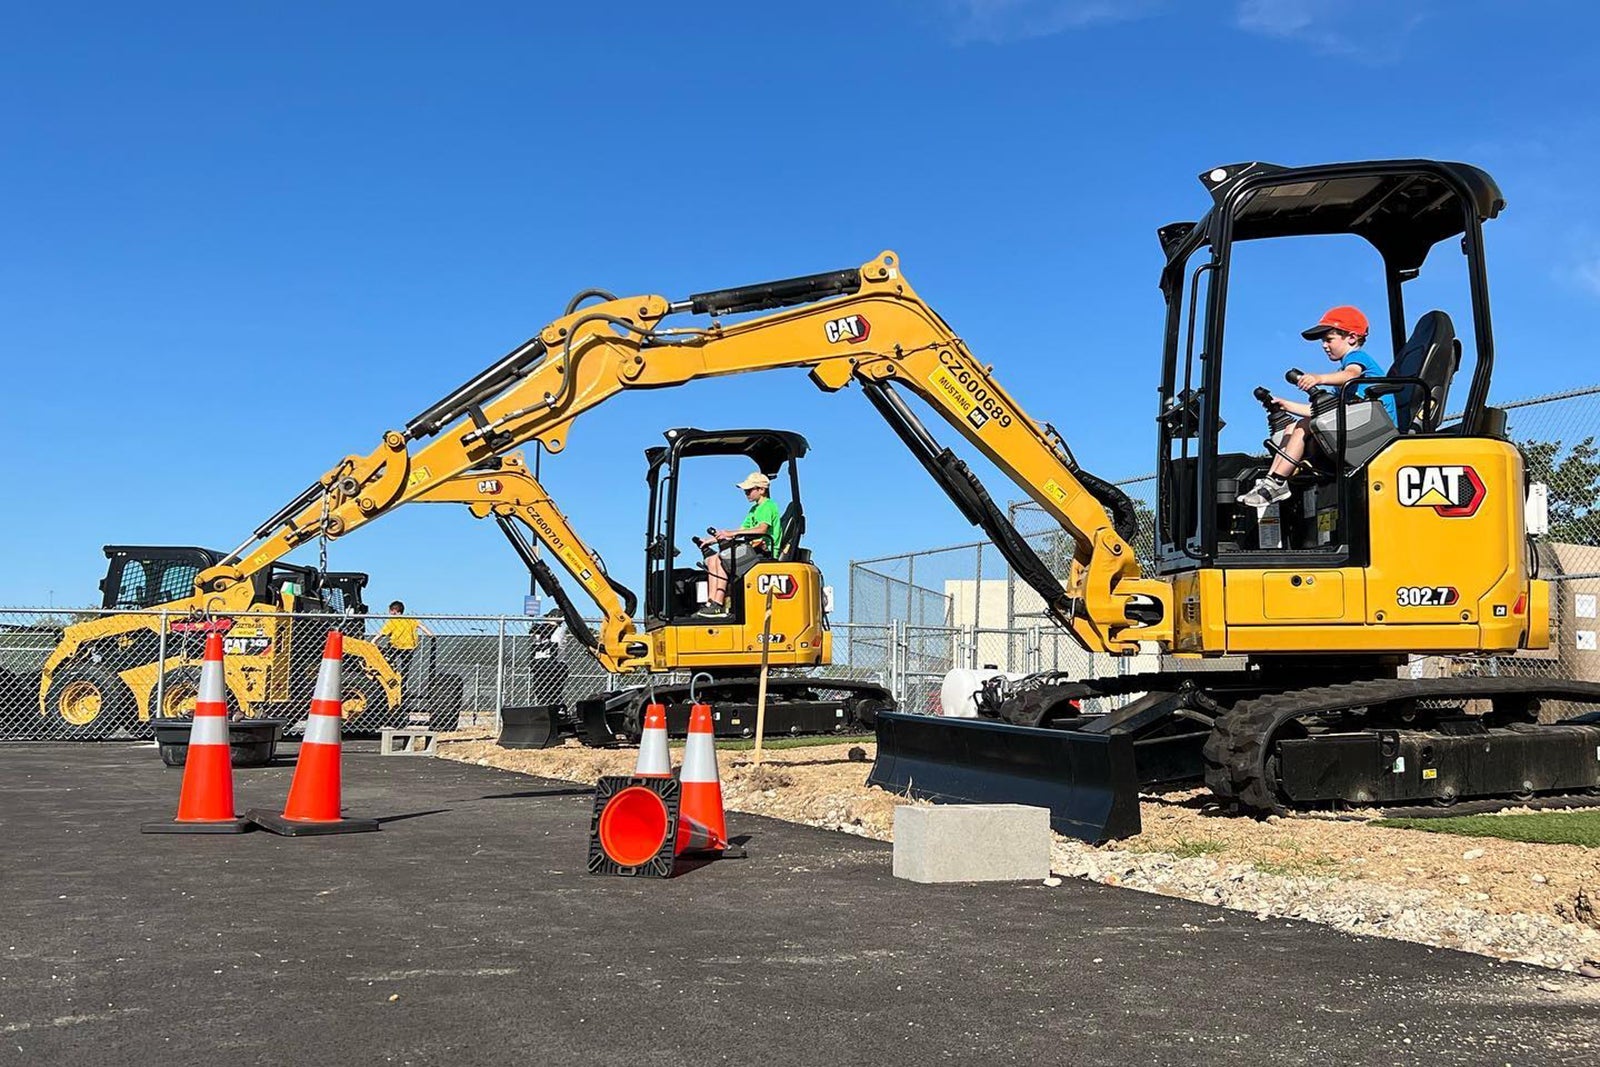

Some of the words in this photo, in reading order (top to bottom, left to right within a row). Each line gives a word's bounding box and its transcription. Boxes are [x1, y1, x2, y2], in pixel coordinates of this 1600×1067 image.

[826, 315, 859, 343] CAT
[938, 376, 970, 411] MUSTANG
[969, 409, 986, 426] CAT
[939, 350, 1012, 428] CZ600689
[478, 480, 498, 493] CAT
[1398, 467, 1464, 506] CAT
[526, 506, 564, 549] CZ600701
[758, 574, 789, 594] CAT
[1397, 588, 1449, 605] 302.7
[223, 639, 248, 654] CAT
[757, 634, 782, 644] 32.7
